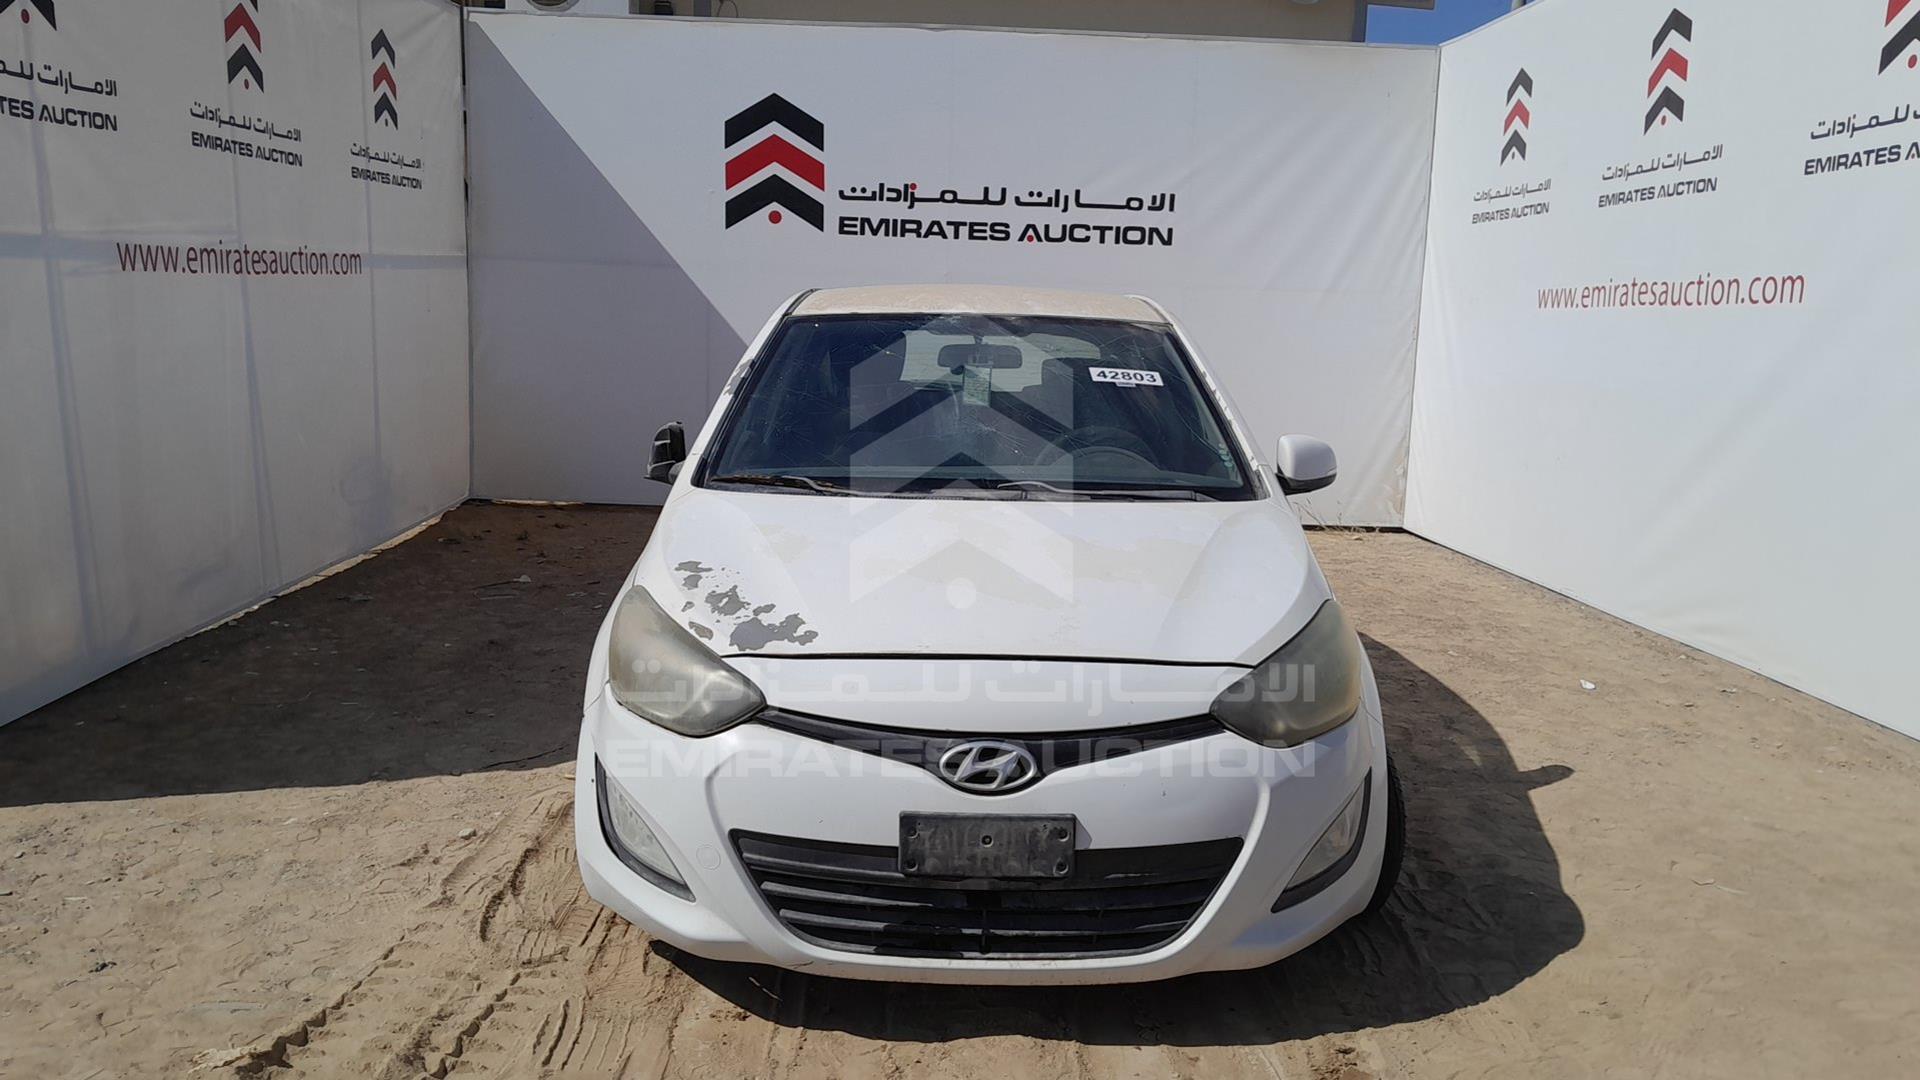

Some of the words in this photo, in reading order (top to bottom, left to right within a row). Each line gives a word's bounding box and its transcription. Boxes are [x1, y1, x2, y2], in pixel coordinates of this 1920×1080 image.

[39, 104, 118, 131] AUCTION
[191, 131, 253, 158] EMIRATES
[255, 145, 303, 167] AUCTION
[1804, 144, 1902, 175] EMIRATES
[351, 166, 391, 185] EMIRATES
[391, 174, 423, 190] AUCTION
[1598, 186, 1656, 208] EMIRATES
[1657, 177, 1718, 199] AUCTION
[1472, 208, 1510, 224] EMIRATES
[1510, 202, 1550, 219] AUCTION
[838, 216, 1010, 241] EMIRATES
[1017, 223, 1174, 246] AUCTION
[117, 240, 363, 276] www.emiratesauction.com
[1537, 272, 1805, 309] www.emiratesauction.com
[1097, 370, 1157, 383] 42803
